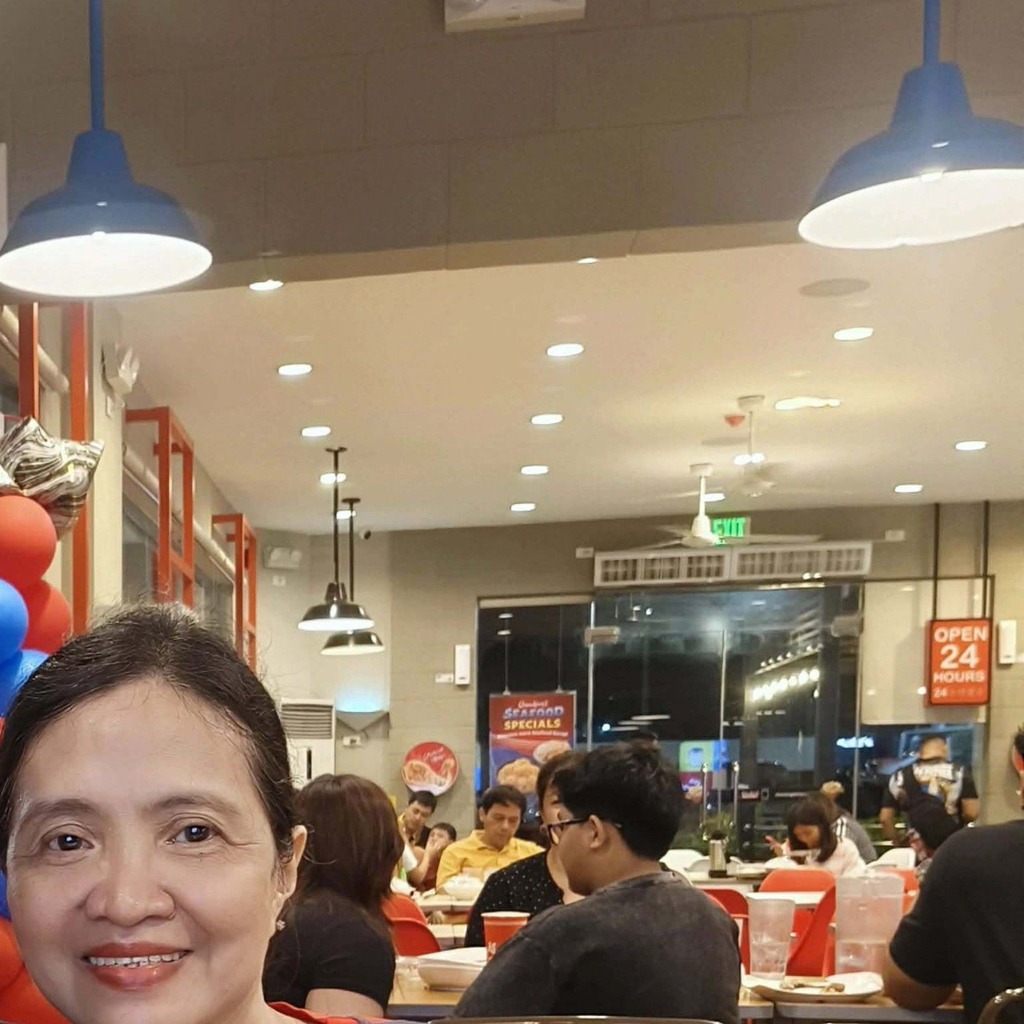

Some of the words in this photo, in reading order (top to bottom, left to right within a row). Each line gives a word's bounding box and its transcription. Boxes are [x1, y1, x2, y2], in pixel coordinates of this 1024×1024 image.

[713, 516, 745, 537] EXIT
[934, 626, 988, 642] OPEN
[940, 643, 979, 670] 24
[933, 670, 985, 683] HOURS
[503, 705, 564, 719] SEAFOOD
[503, 718, 561, 730] SPECIALS
